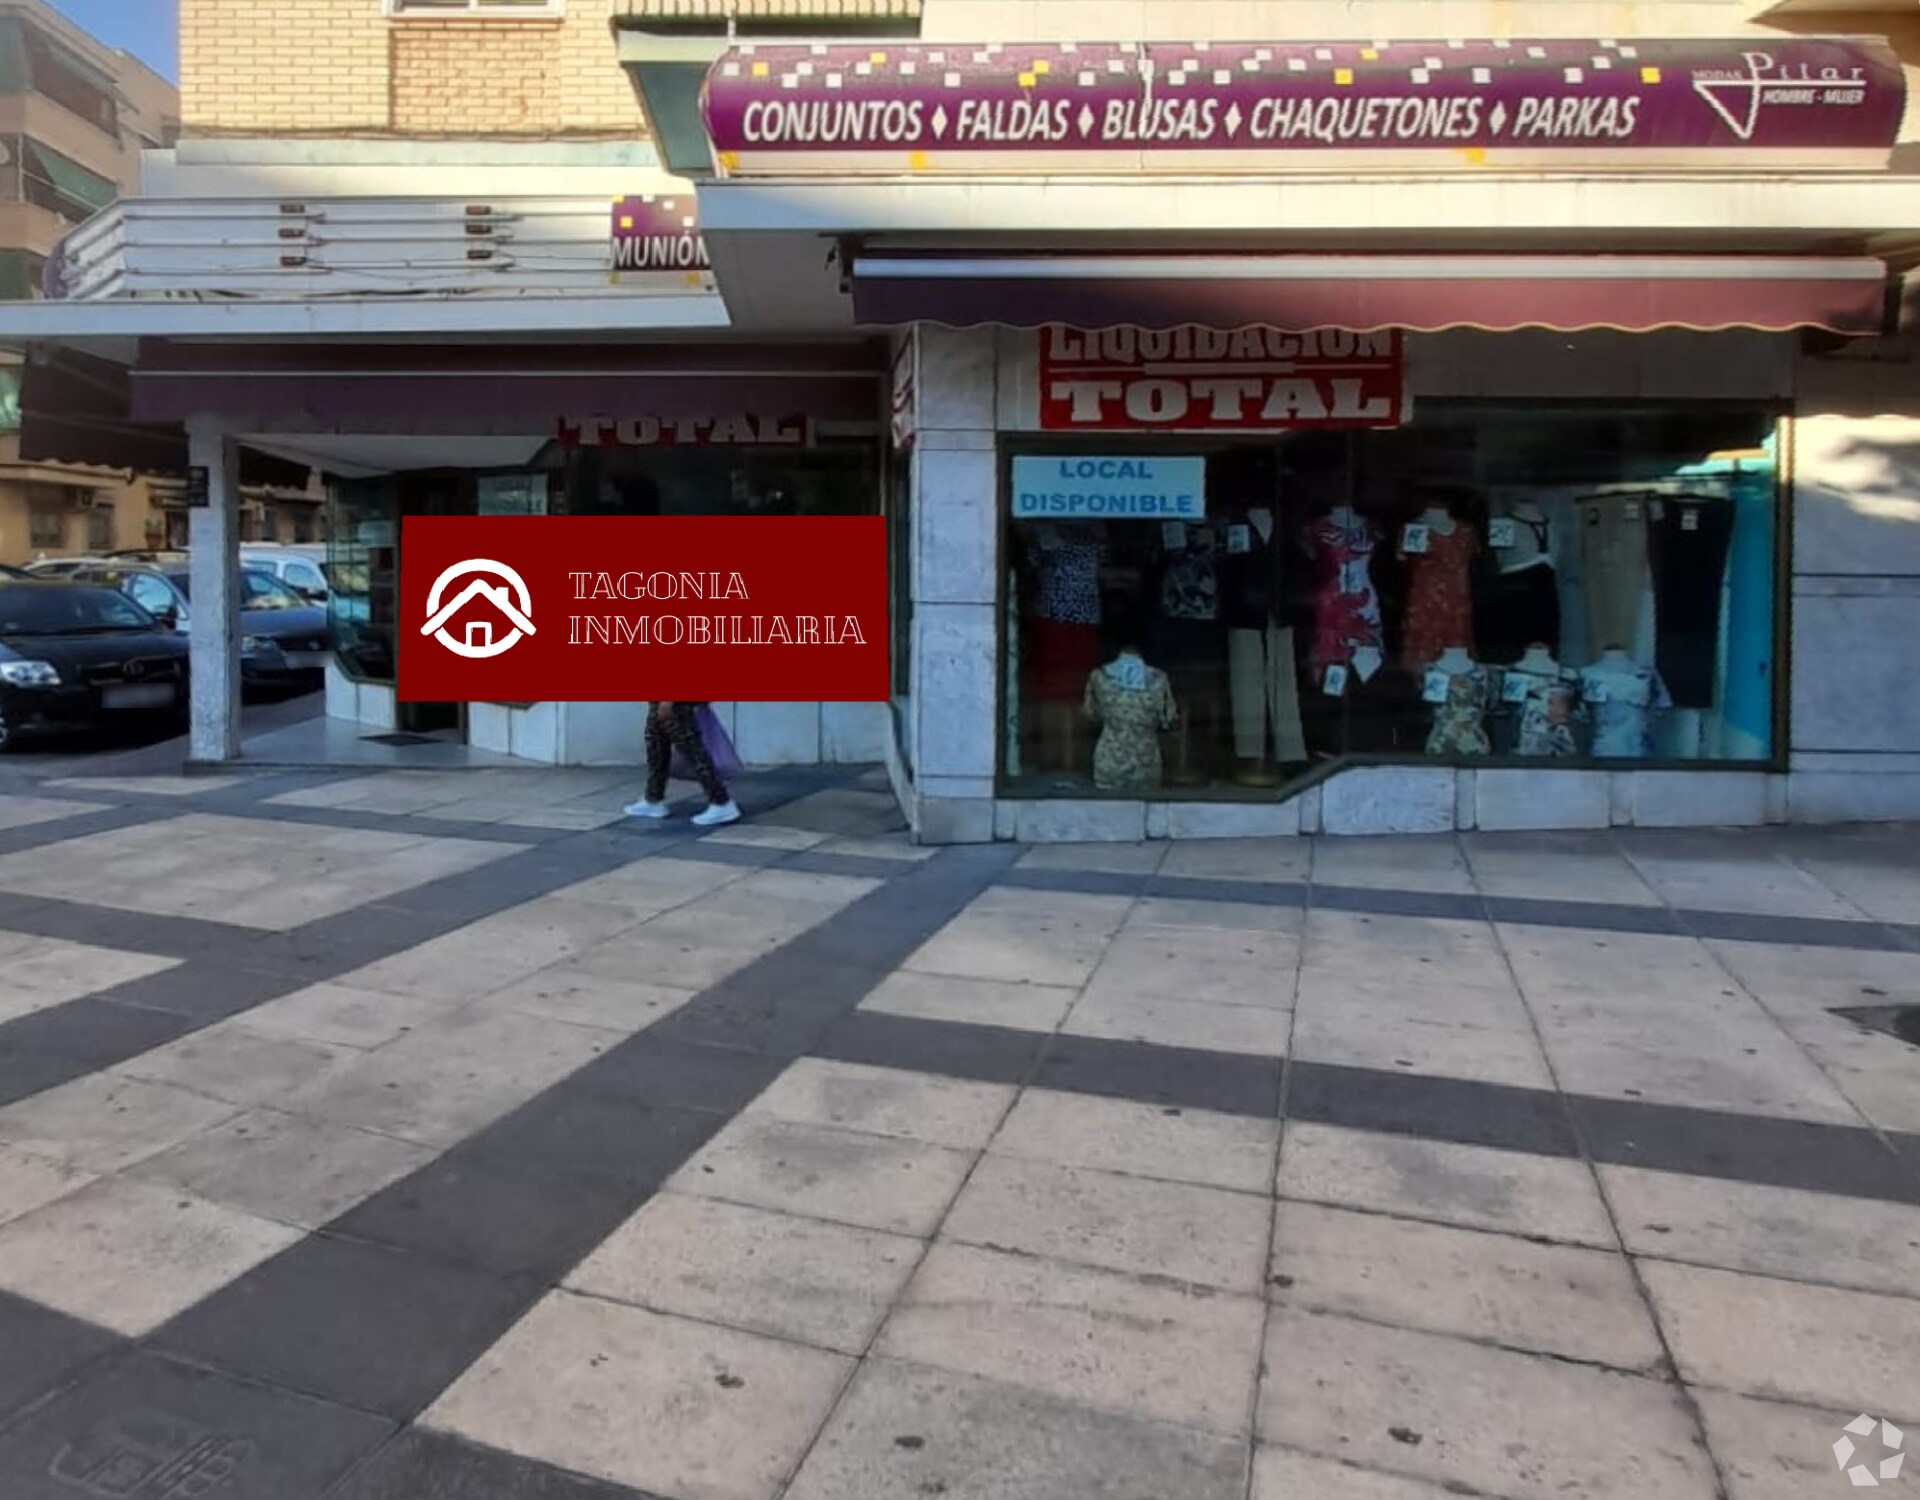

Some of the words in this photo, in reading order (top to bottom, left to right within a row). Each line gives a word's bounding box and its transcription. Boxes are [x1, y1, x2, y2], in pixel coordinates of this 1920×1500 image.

[1741, 52, 1865, 81] Pilar
[1762, 88, 1816, 105] HOMBRE
[1822, 88, 1865, 105] MUJER
[742, 99, 924, 142] CONJUNTOS
[955, 98, 1070, 142] FALDAS
[1102, 97, 1217, 141] BLUSAS
[1249, 97, 1484, 144] CHAQUETONES
[1511, 96, 1642, 138] PARKAS
[1050, 378, 1391, 422] TOTAL
[563, 416, 800, 445] TOTAL
[1059, 460, 1154, 479] LOCAL
[1020, 493, 1193, 513] DISPONIBLE
